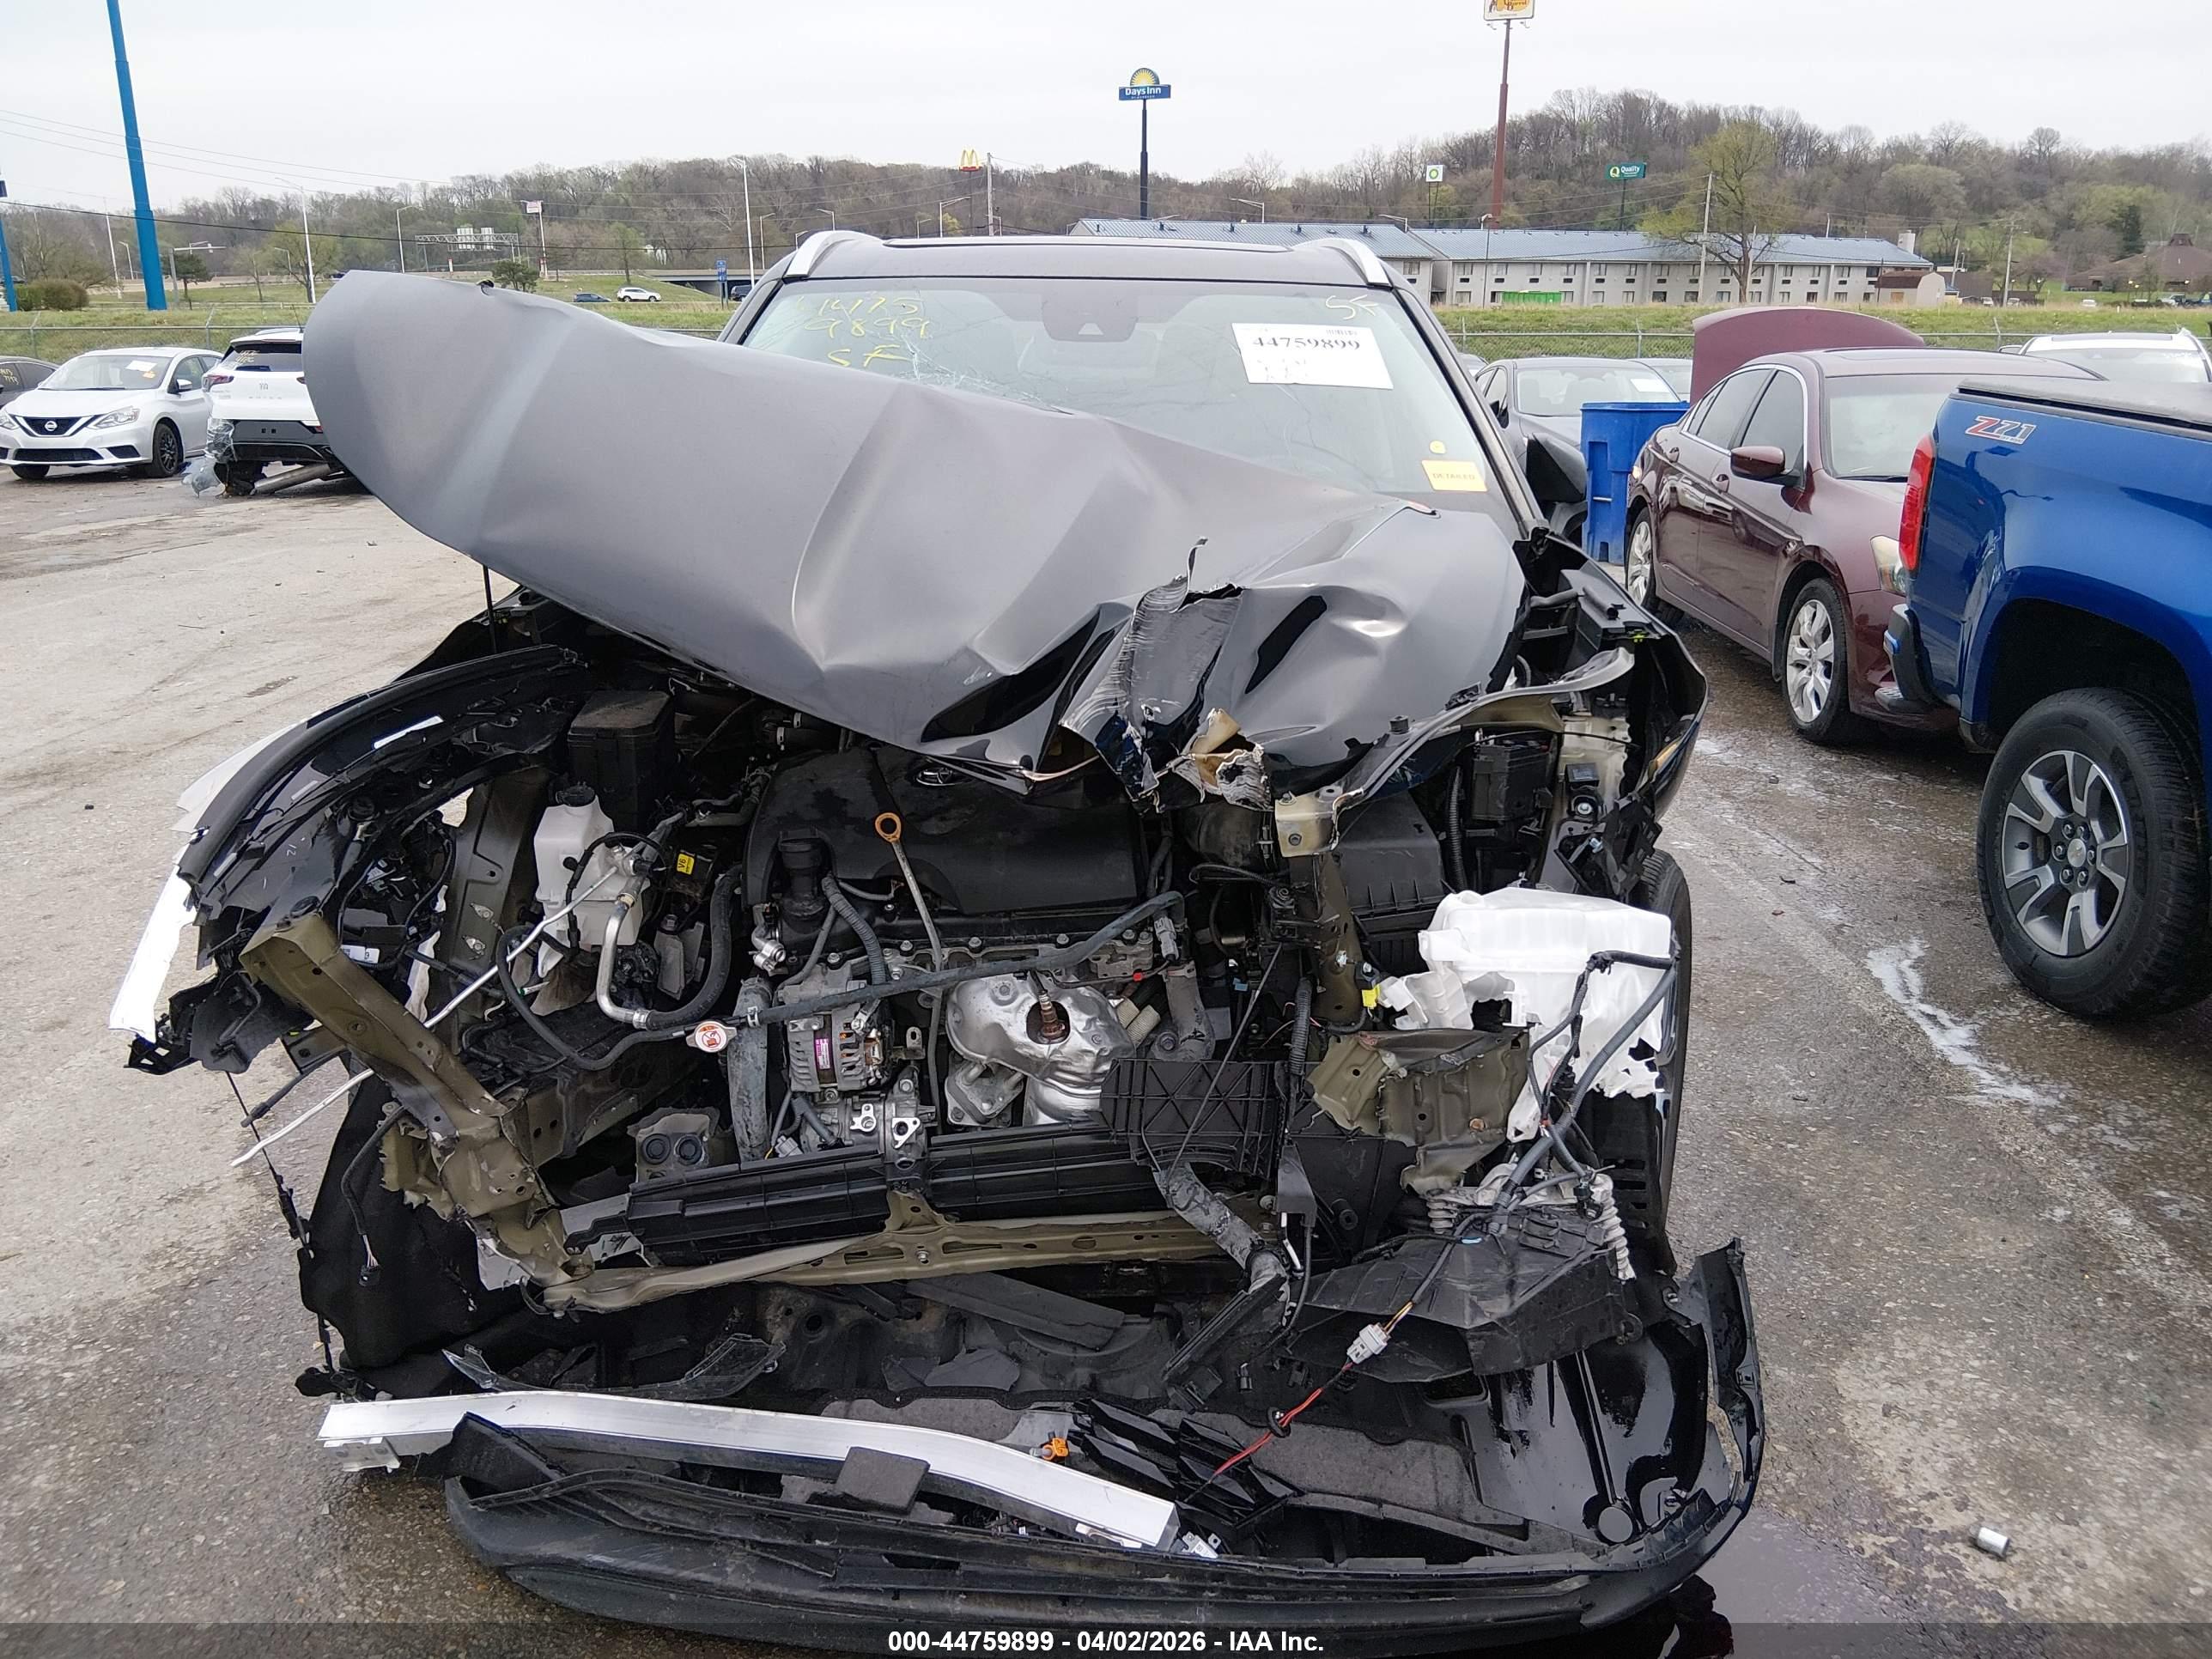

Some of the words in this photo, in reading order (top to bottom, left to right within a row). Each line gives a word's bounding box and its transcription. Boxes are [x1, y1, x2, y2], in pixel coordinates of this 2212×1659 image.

[1125, 88, 1146, 96] Days
[1146, 86, 1162, 94] Inn
[1252, 337, 1361, 350] 44759899
[1965, 416, 2037, 442] Z71
